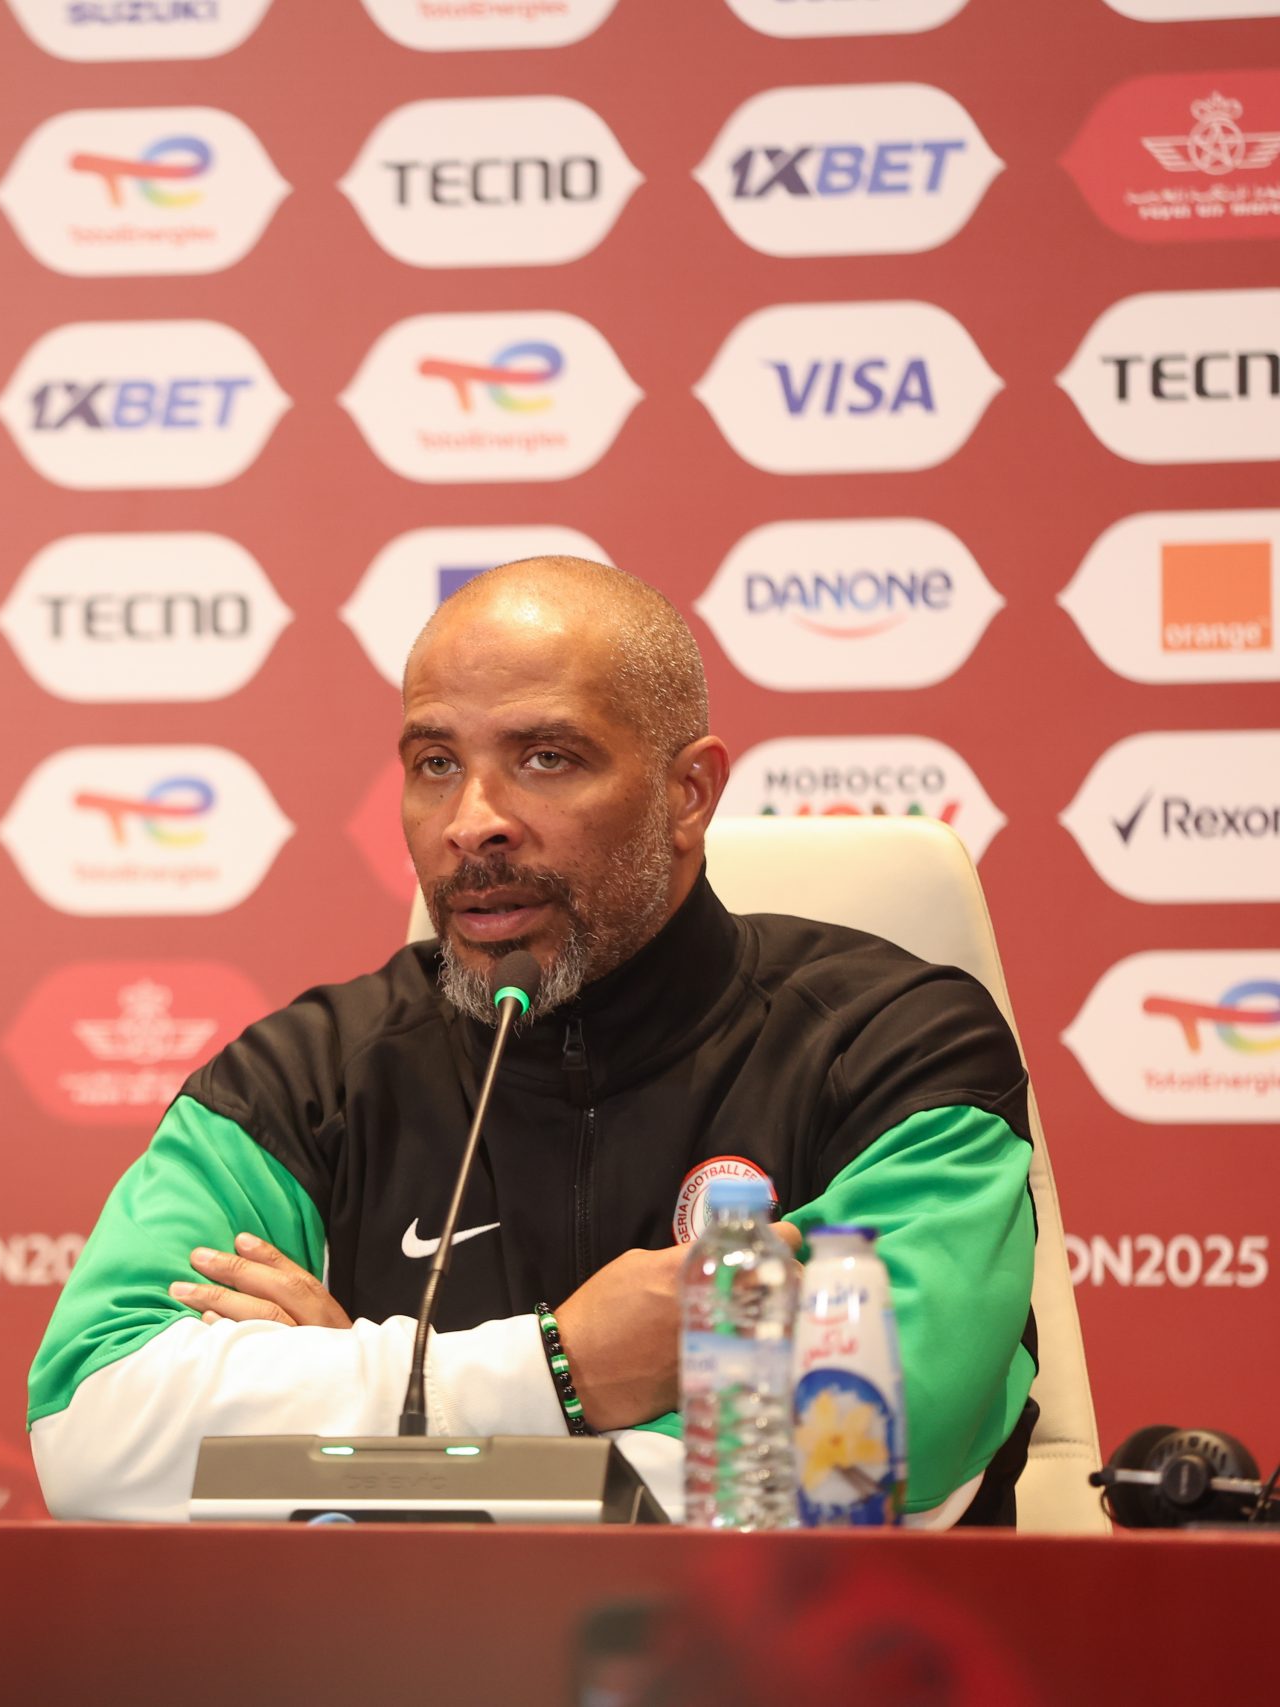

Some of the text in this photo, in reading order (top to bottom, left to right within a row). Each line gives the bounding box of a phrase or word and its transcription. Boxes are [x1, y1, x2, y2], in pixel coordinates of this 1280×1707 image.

[383, 157, 600, 206] TECNO
[731, 141, 965, 199] 1XBET
[766, 357, 936, 416] VISA
[1102, 351, 1280, 401] TECN
[30, 378, 251, 431] 1XBET
[40, 593, 251, 640] TECNO
[1166, 621, 1261, 653] orange
[765, 767, 946, 793] MOROCCO
[1142, 1070, 1280, 1096] TotalEnergi
[682, 1164, 740, 1202] FOOTBALL
[677, 1203, 691, 1244] GERIA
[1064, 1233, 1269, 1288] ON2025
